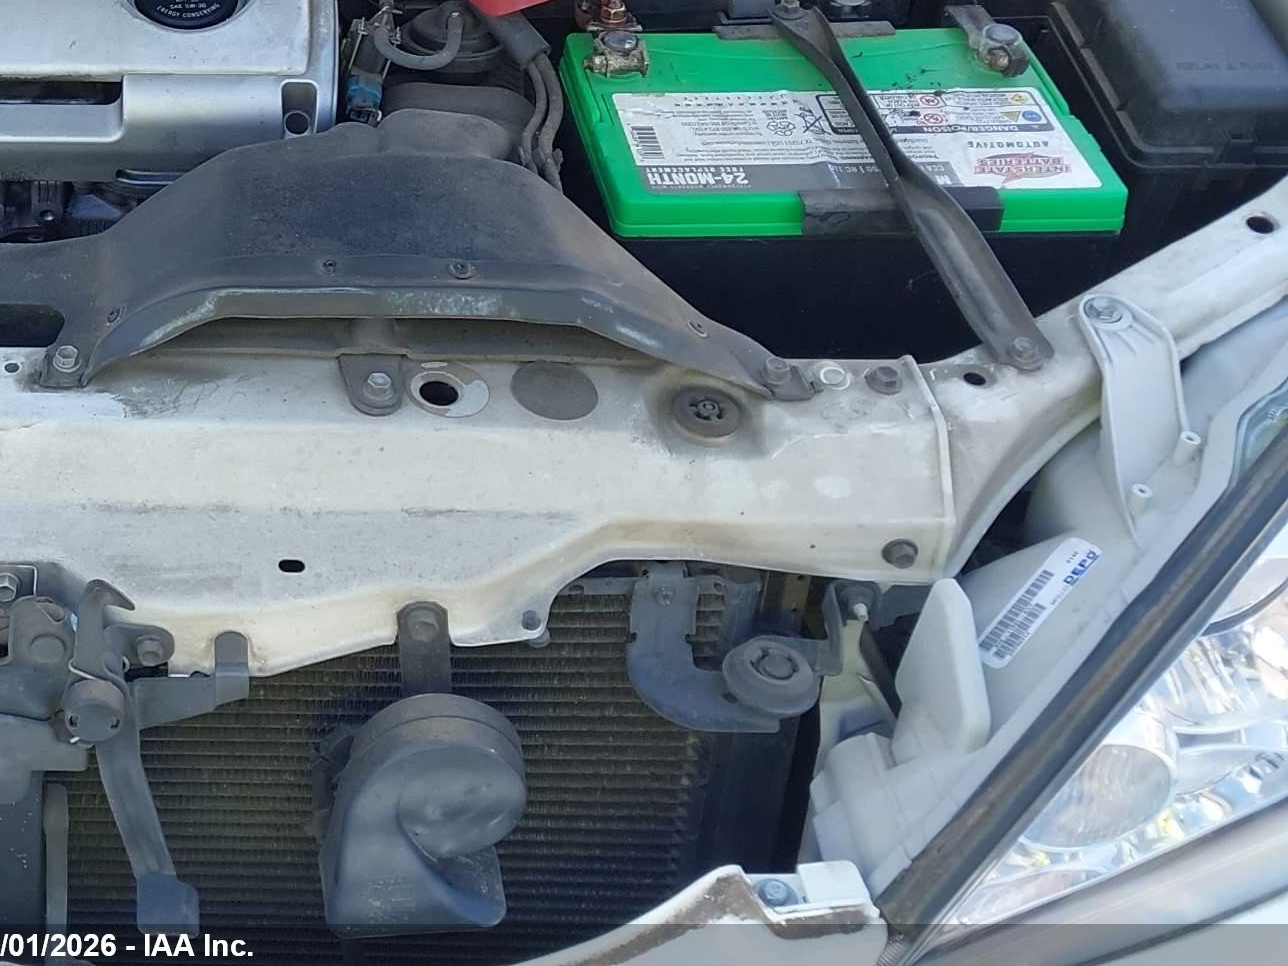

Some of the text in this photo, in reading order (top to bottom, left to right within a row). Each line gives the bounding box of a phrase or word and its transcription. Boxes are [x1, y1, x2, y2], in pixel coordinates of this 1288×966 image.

[968, 141, 1049, 149] AUTOMOTIVE
[977, 165, 1070, 173] INTERSTATE
[647, 172, 749, 185] 24-MONTH
[1064, 550, 1097, 585] DEPO
